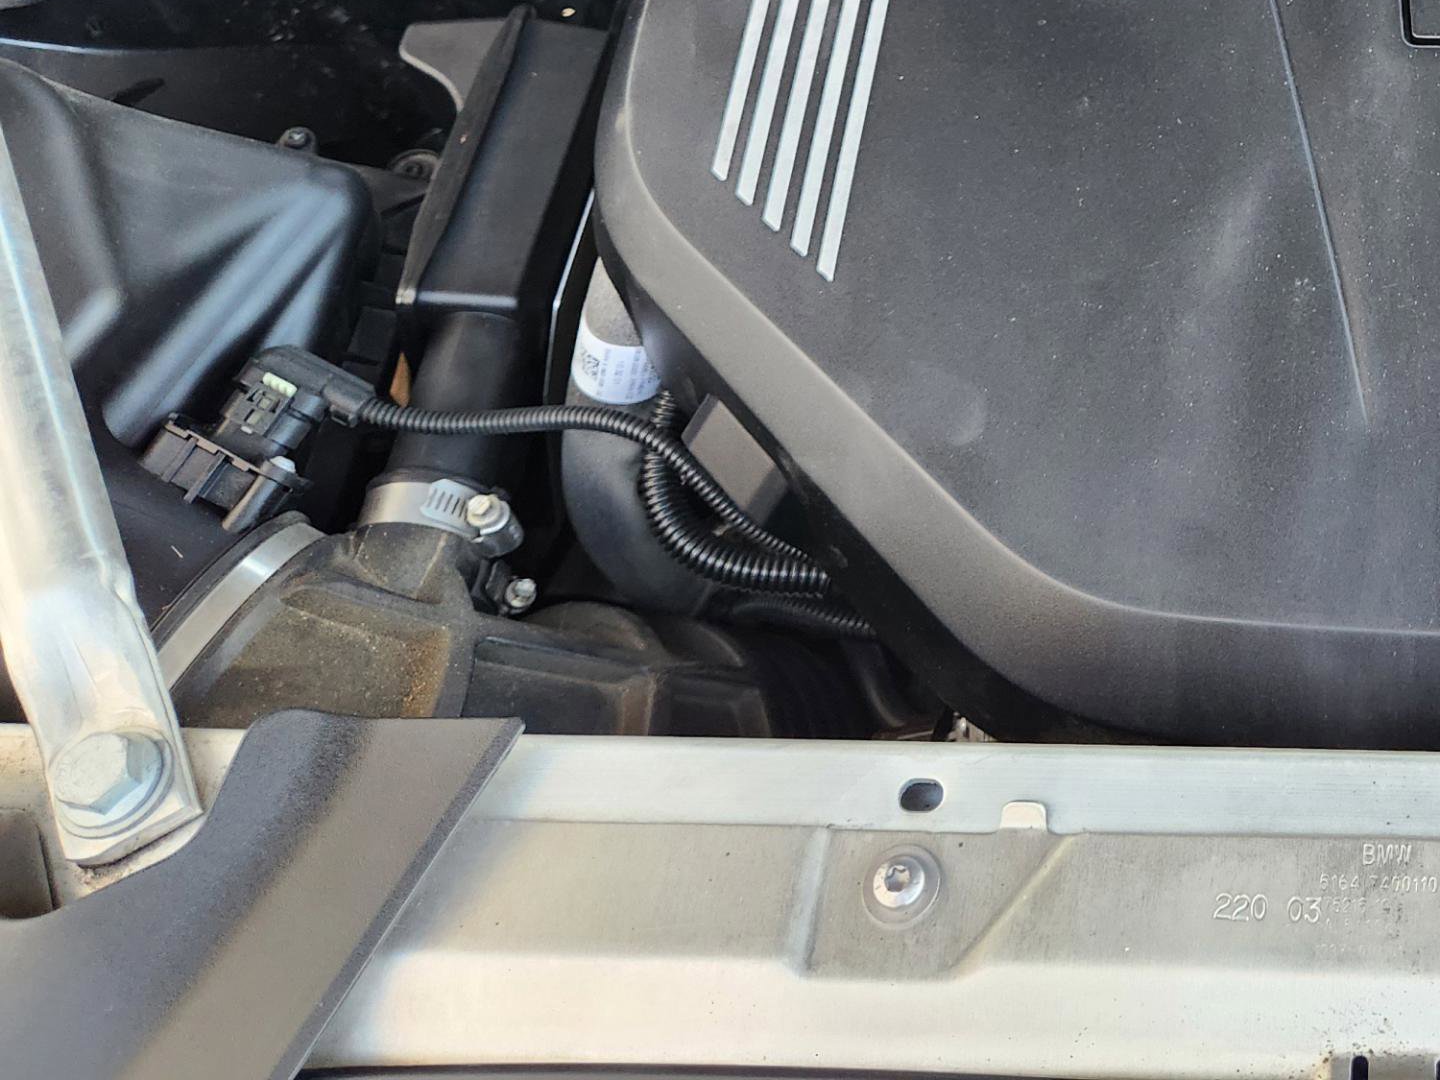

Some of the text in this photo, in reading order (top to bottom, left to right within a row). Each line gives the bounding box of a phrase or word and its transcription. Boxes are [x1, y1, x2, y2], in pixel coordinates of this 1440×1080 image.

[1362, 843, 1412, 866] BMW
[1213, 893, 1322, 923] 220 03
